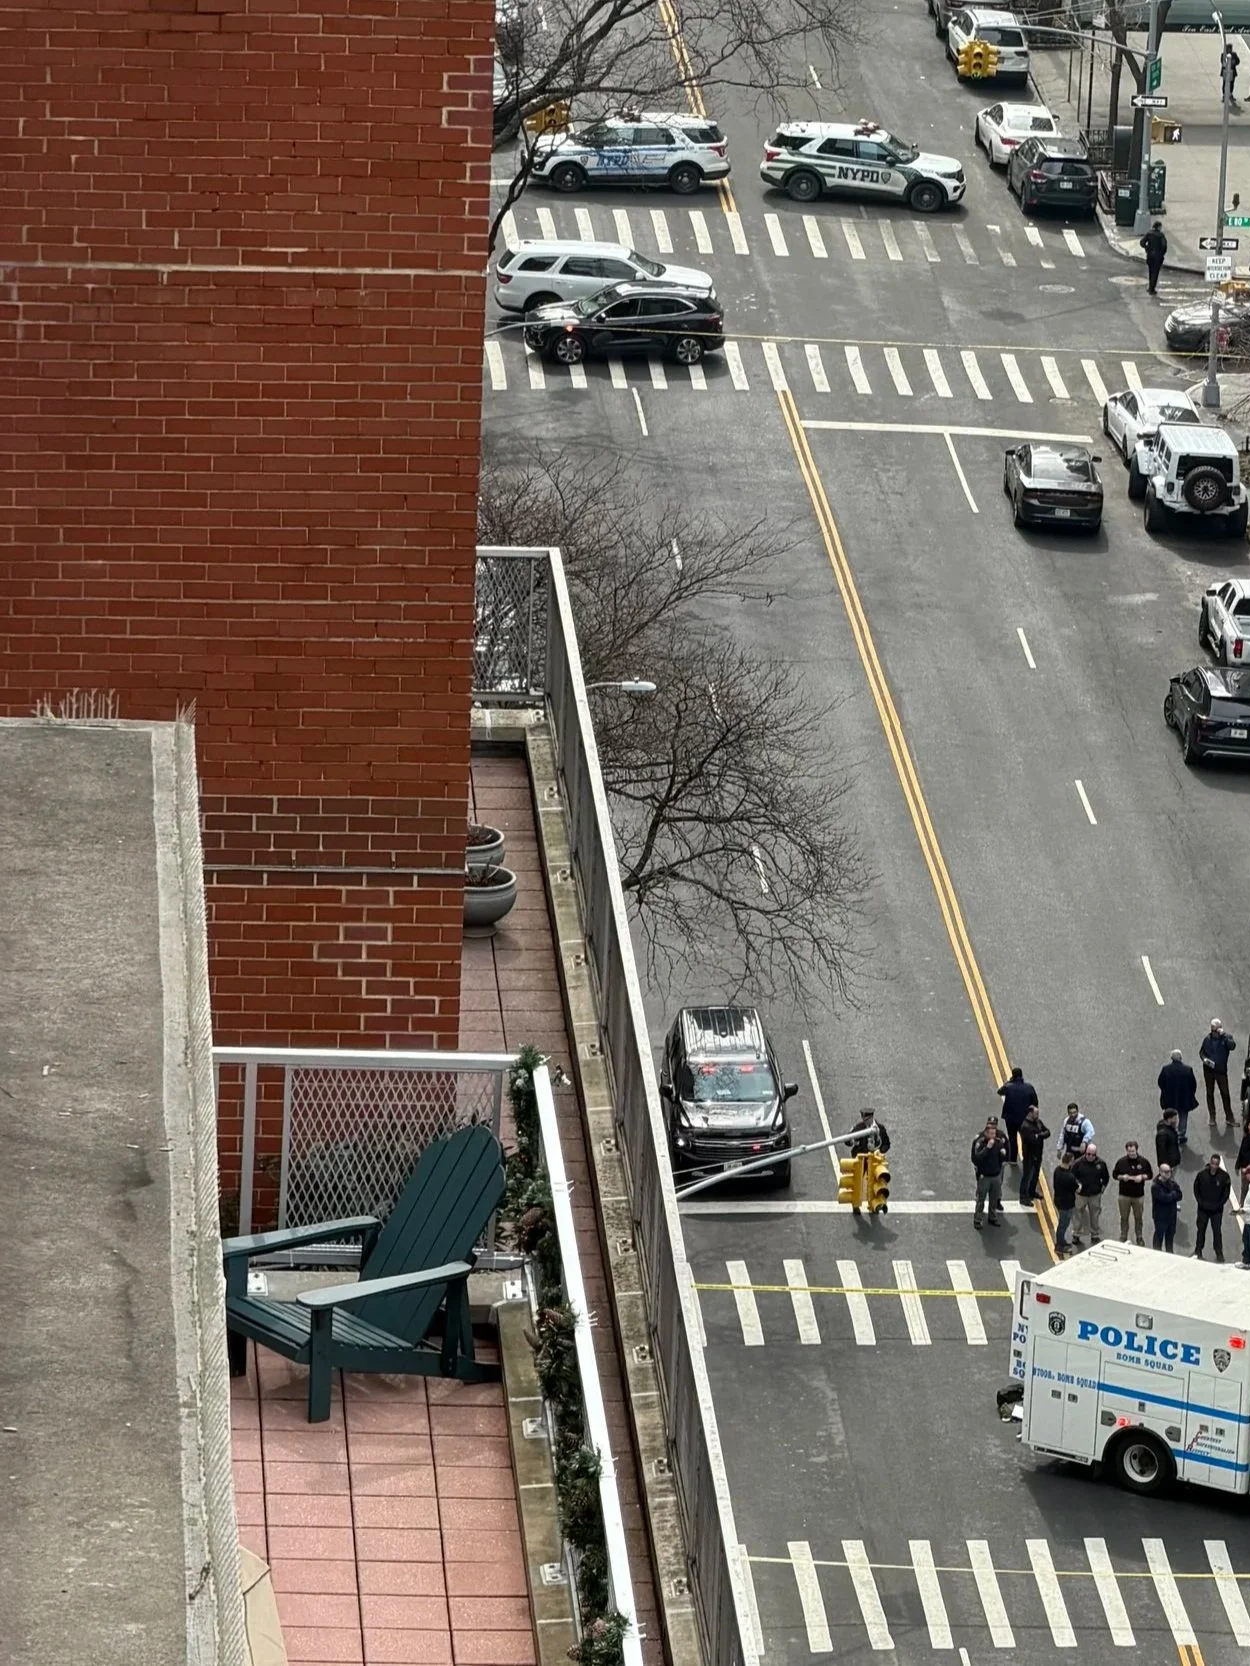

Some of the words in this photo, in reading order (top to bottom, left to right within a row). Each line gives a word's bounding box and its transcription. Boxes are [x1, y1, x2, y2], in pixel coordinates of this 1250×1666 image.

[837, 166, 880, 184] NYPD
[1077, 1319, 1201, 1367] POLICE
[1116, 1352, 1141, 1365] BOMB
[1144, 1358, 1175, 1373] SQUAD
[1076, 1376, 1097, 1390] SQUAD
